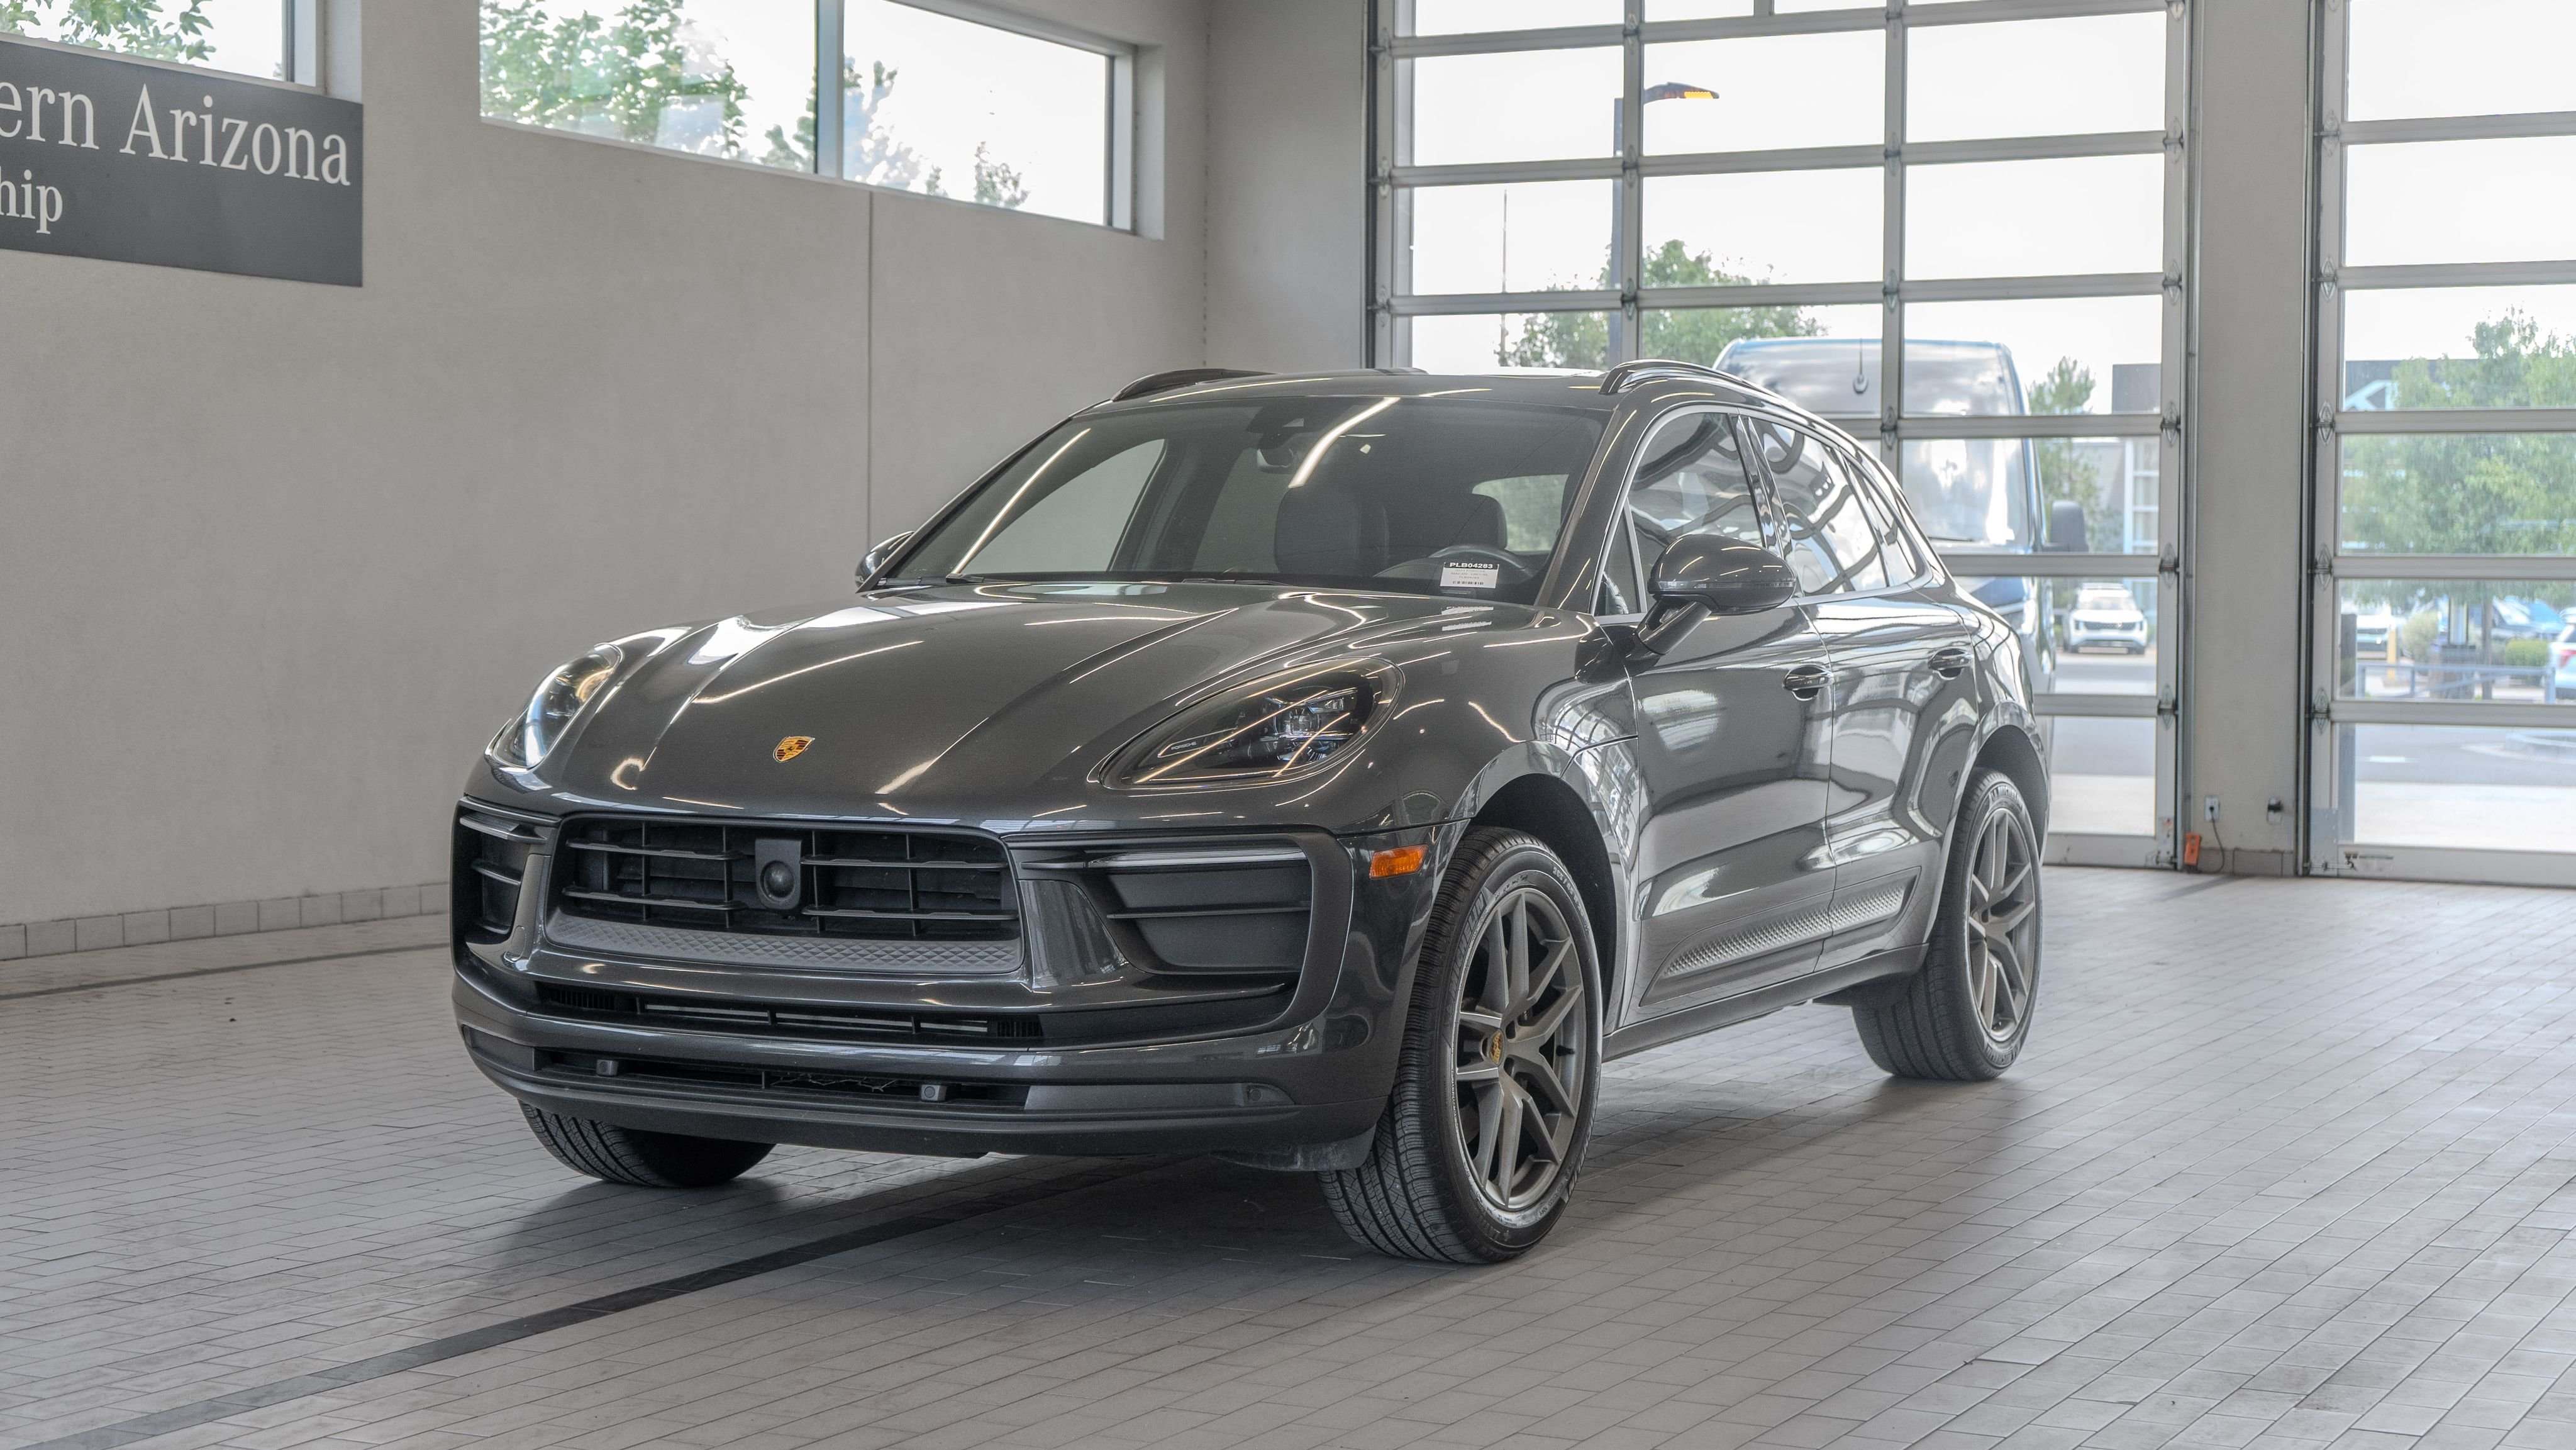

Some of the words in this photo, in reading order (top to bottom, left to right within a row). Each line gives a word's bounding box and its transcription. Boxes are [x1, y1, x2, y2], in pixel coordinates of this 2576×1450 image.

[0, 82, 99, 150] ern
[119, 83, 350, 186] Arizona
[1171, 742, 1196, 750] PORSCHE
[1448, 891, 1486, 999] MICHELIN
